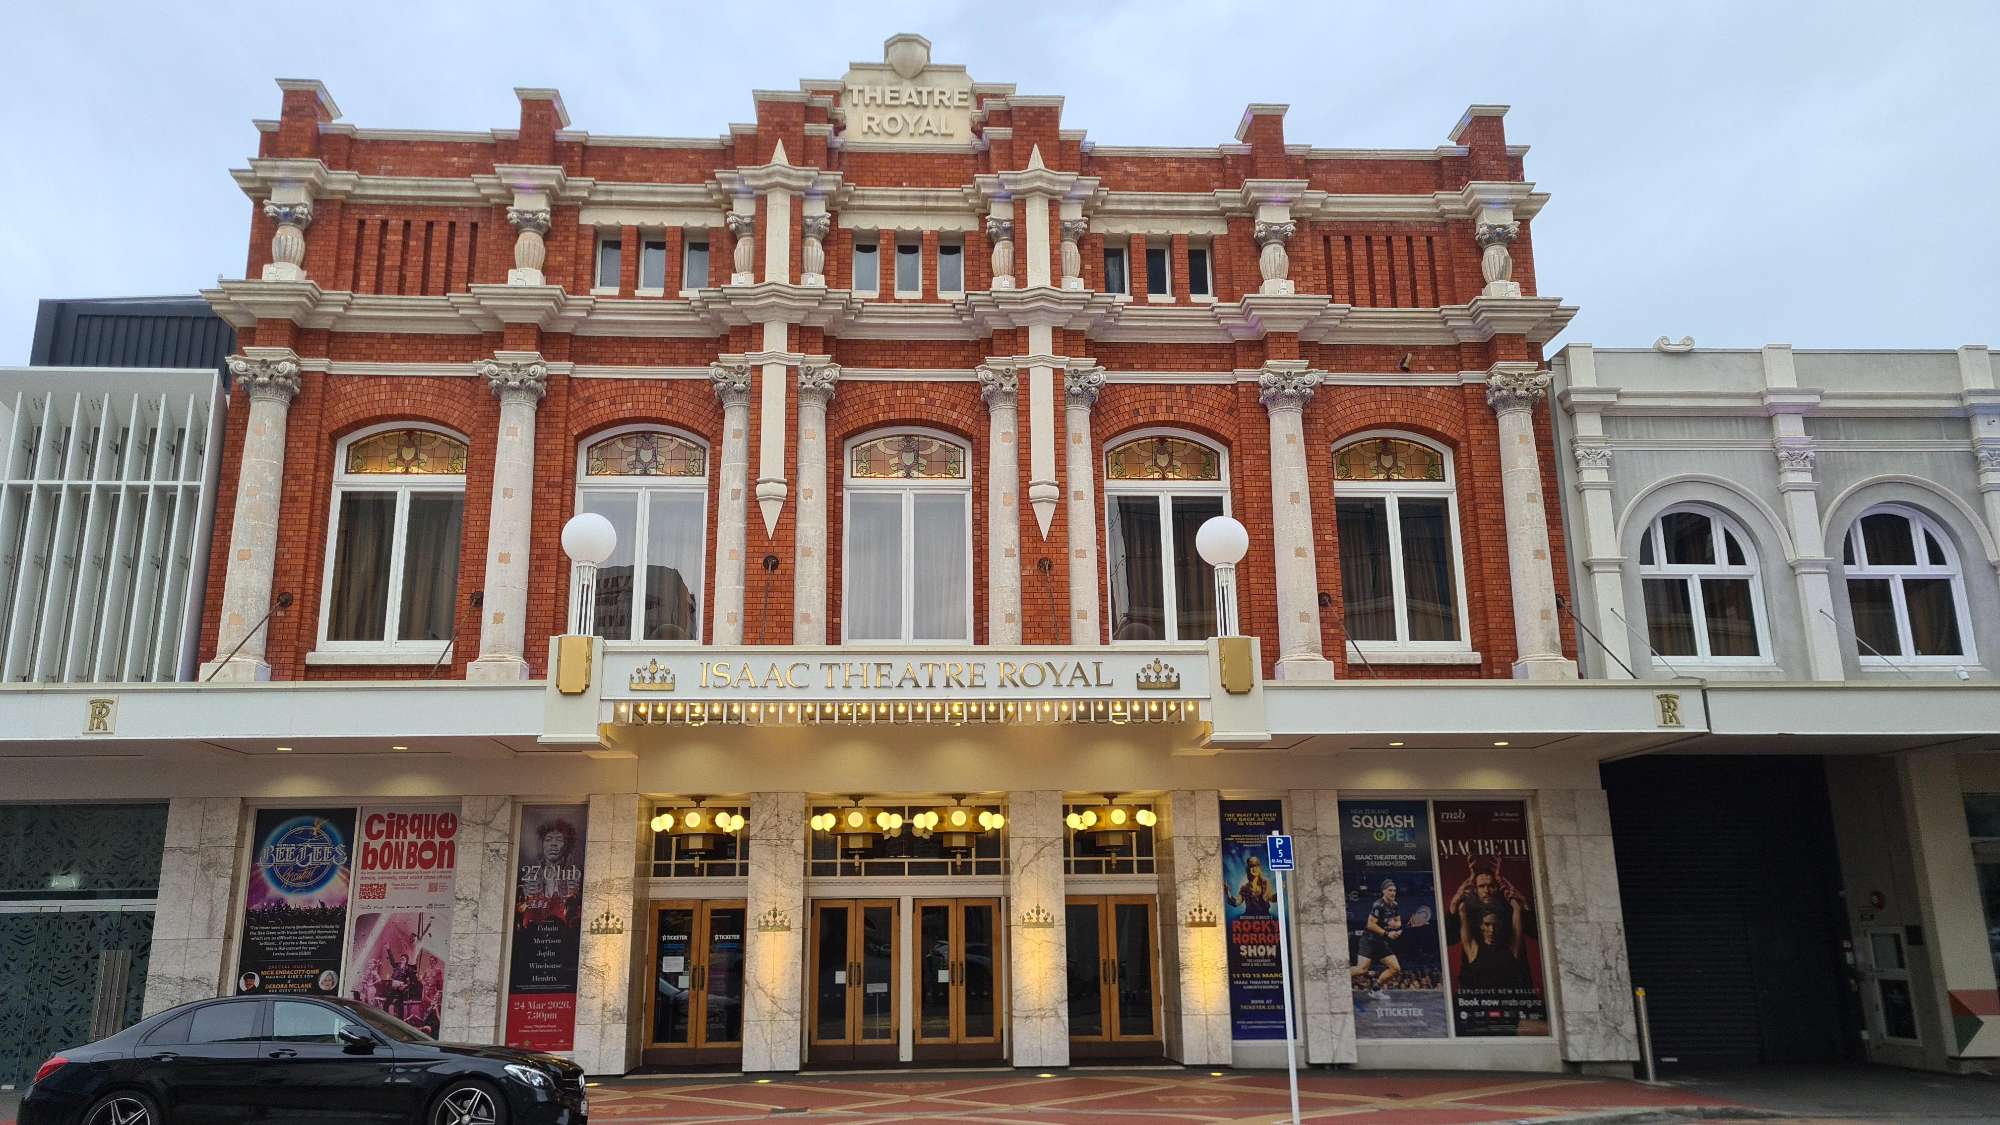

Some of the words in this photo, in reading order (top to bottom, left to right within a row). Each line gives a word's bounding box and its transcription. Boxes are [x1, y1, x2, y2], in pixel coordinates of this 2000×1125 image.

[848, 86, 970, 108] THEATRE
[862, 112, 954, 136] ROYAL
[699, 662, 810, 688] ISAAC
[820, 661, 988, 688] THEATRE
[997, 661, 1114, 688] ROYAL
[1352, 815, 1415, 828] SQUASH
[1276, 838, 1284, 849] P
[1440, 840, 1526, 856] MACBETH
[1278, 849, 1284, 858] 5
[521, 865, 541, 880] 27
[544, 864, 582, 880] Club
[1232, 920, 1280, 933] ROCKY
[1240, 945, 1276, 957] SHOW
[1458, 998, 1479, 1006] Book
